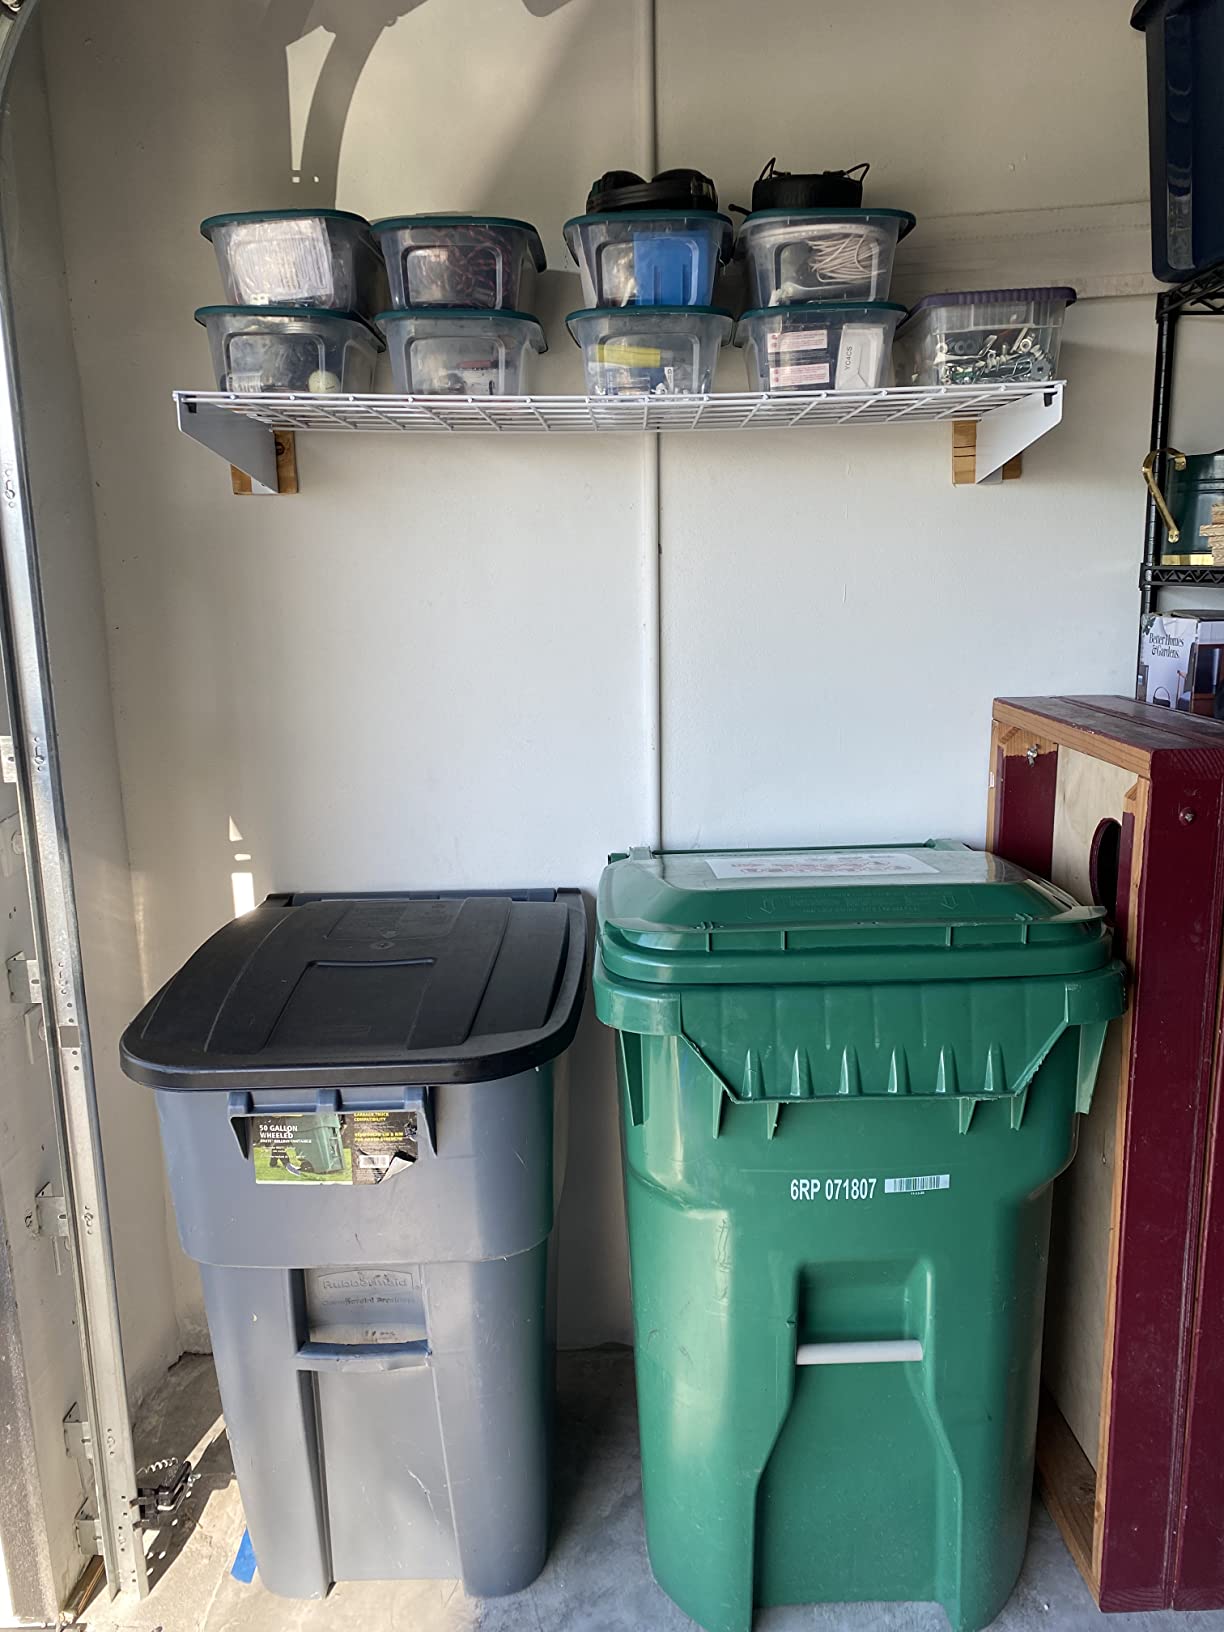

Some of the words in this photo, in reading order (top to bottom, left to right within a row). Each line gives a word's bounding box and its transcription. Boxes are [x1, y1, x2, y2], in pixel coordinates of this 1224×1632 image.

[1149, 633, 1165, 645] Better
[1165, 634, 1184, 647] Homes
[790, 1178, 820, 1201] 6RP
[825, 1178, 877, 1200] 071807
[322, 1278, 408, 1289] Rubbermaid
